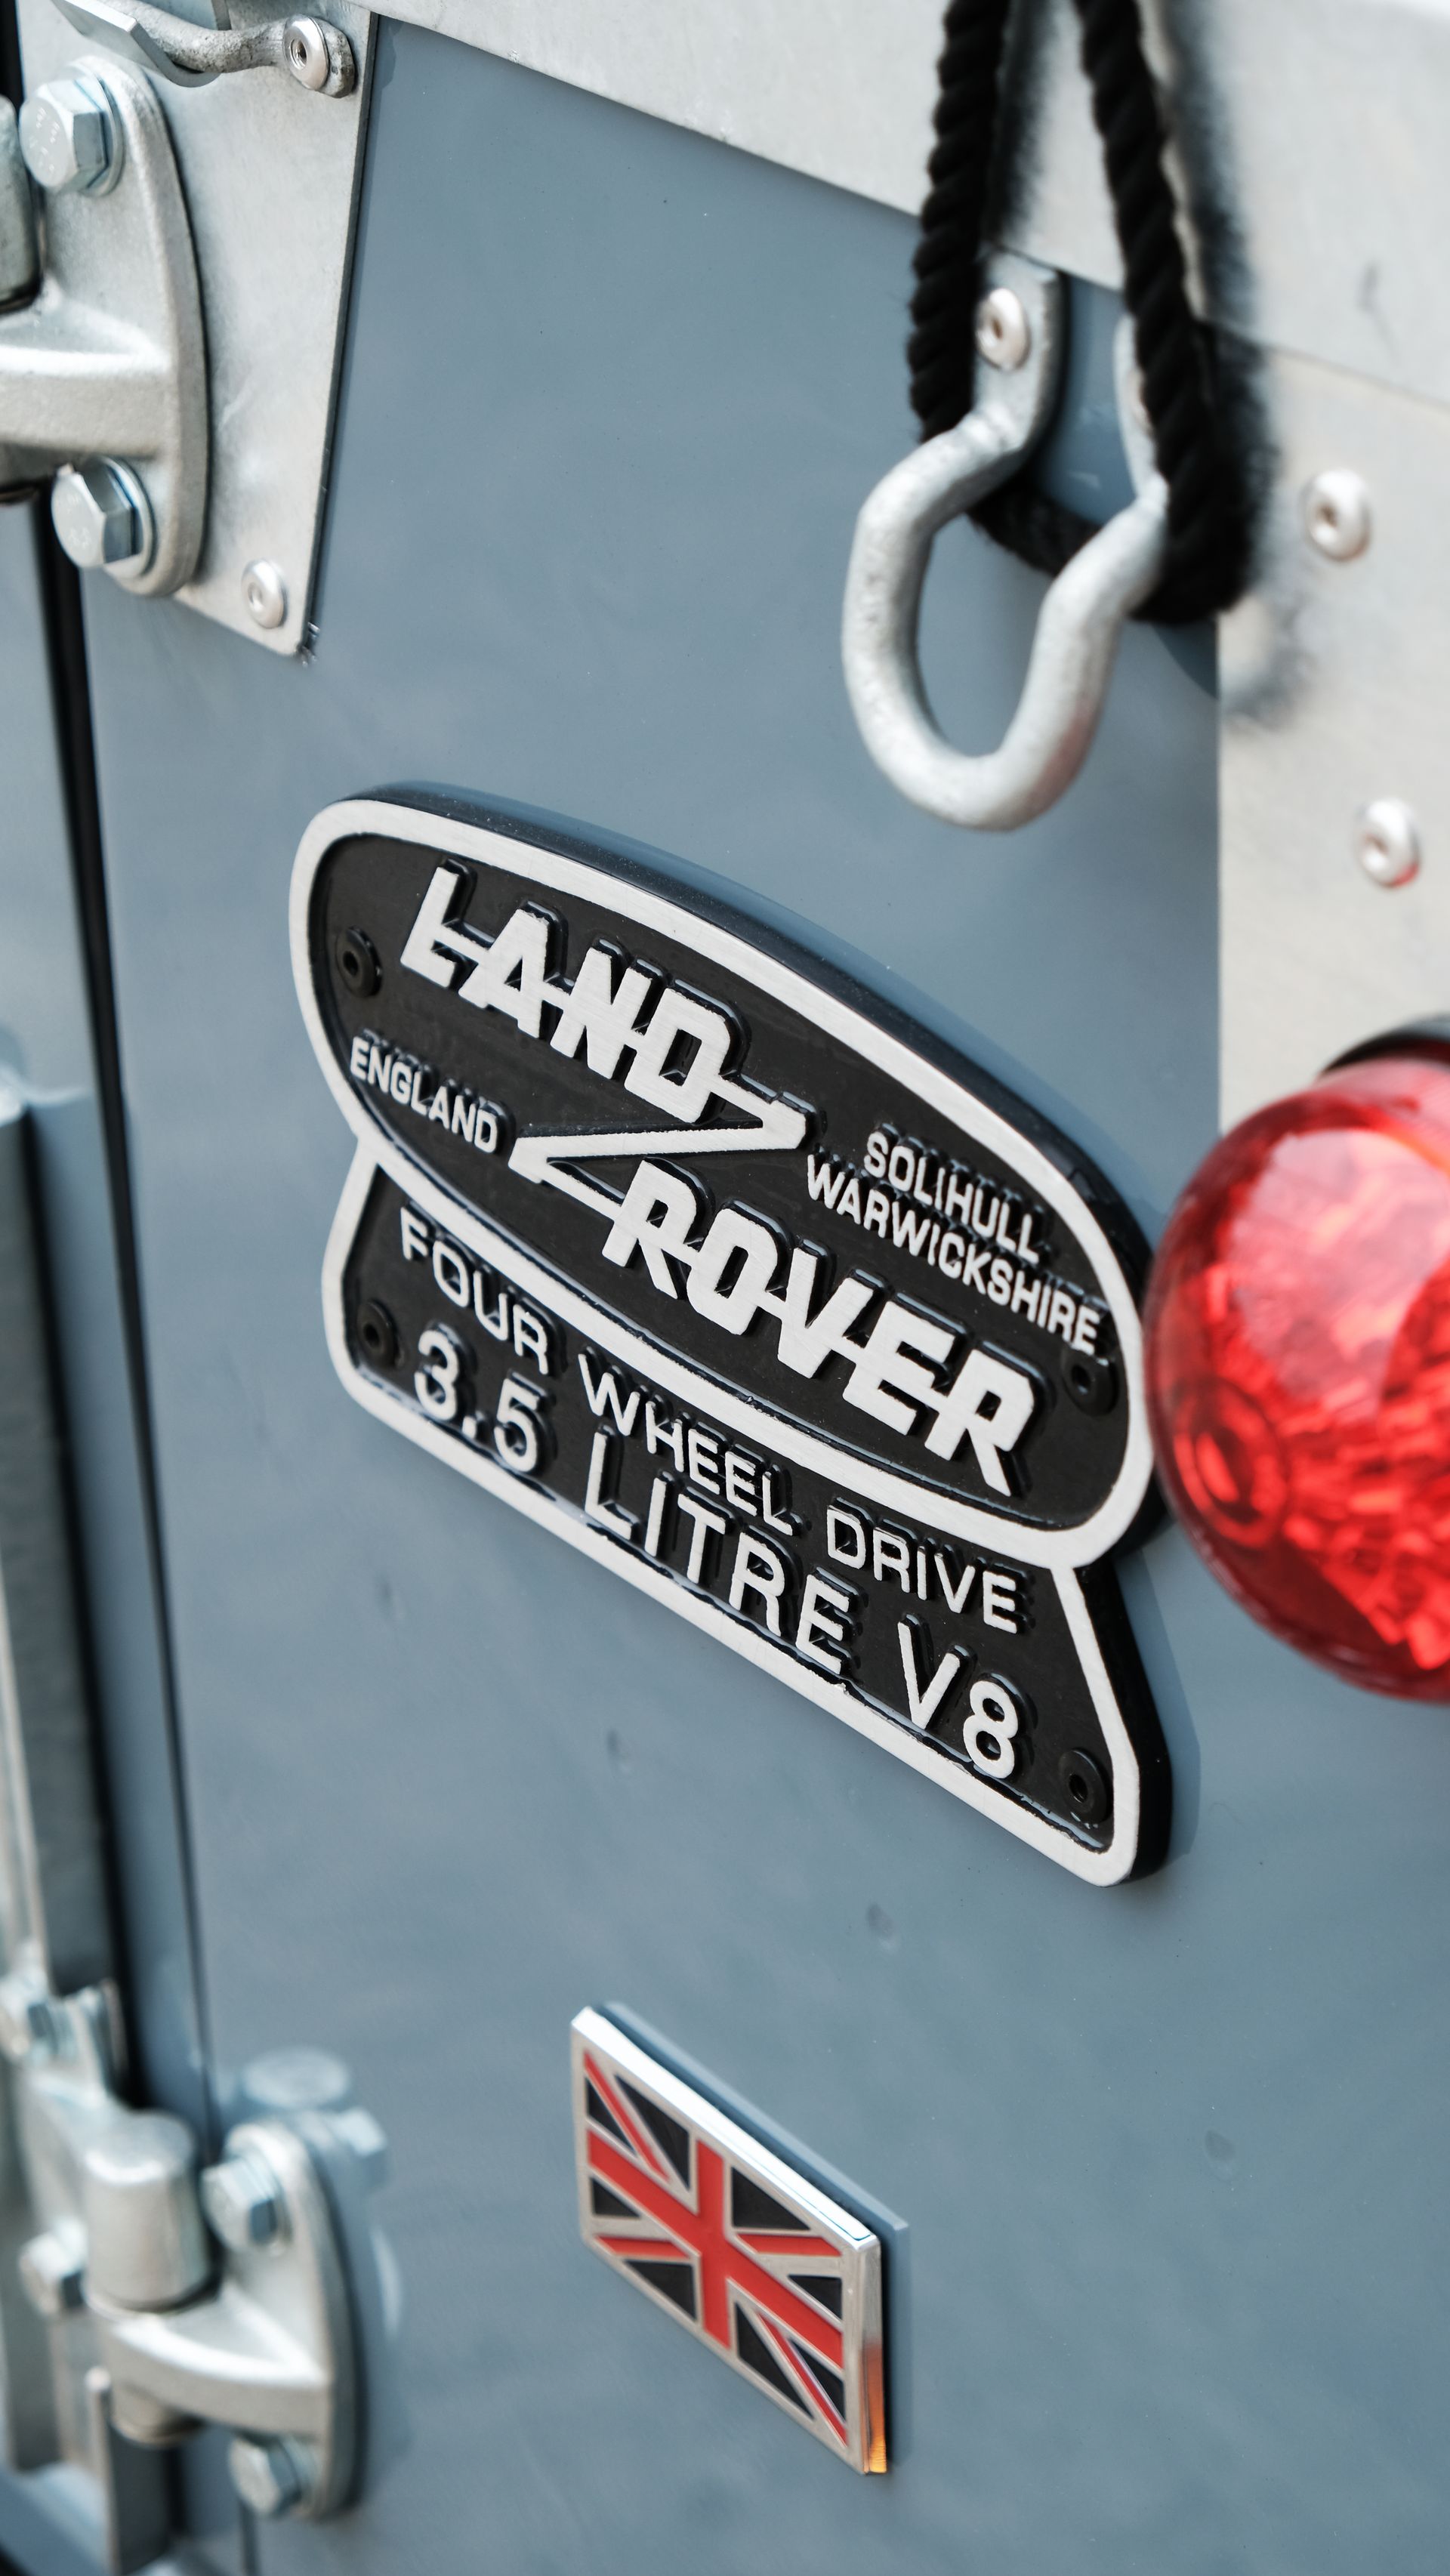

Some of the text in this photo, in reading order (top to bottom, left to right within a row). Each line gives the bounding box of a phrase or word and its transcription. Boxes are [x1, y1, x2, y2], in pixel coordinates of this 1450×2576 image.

[350, 1035, 499, 1154] ENGLAND
[400, 865, 732, 1124] LAND
[806, 1152, 1101, 1356] WARWICKSHIRE
[863, 1130, 1041, 1265] SOLIHULL
[400, 1206, 1017, 1634] FOUR WHEEL DRIVE
[601, 1158, 1035, 1497] ROVER
[414, 1329, 1019, 1779] 3.5 LITRE V8
